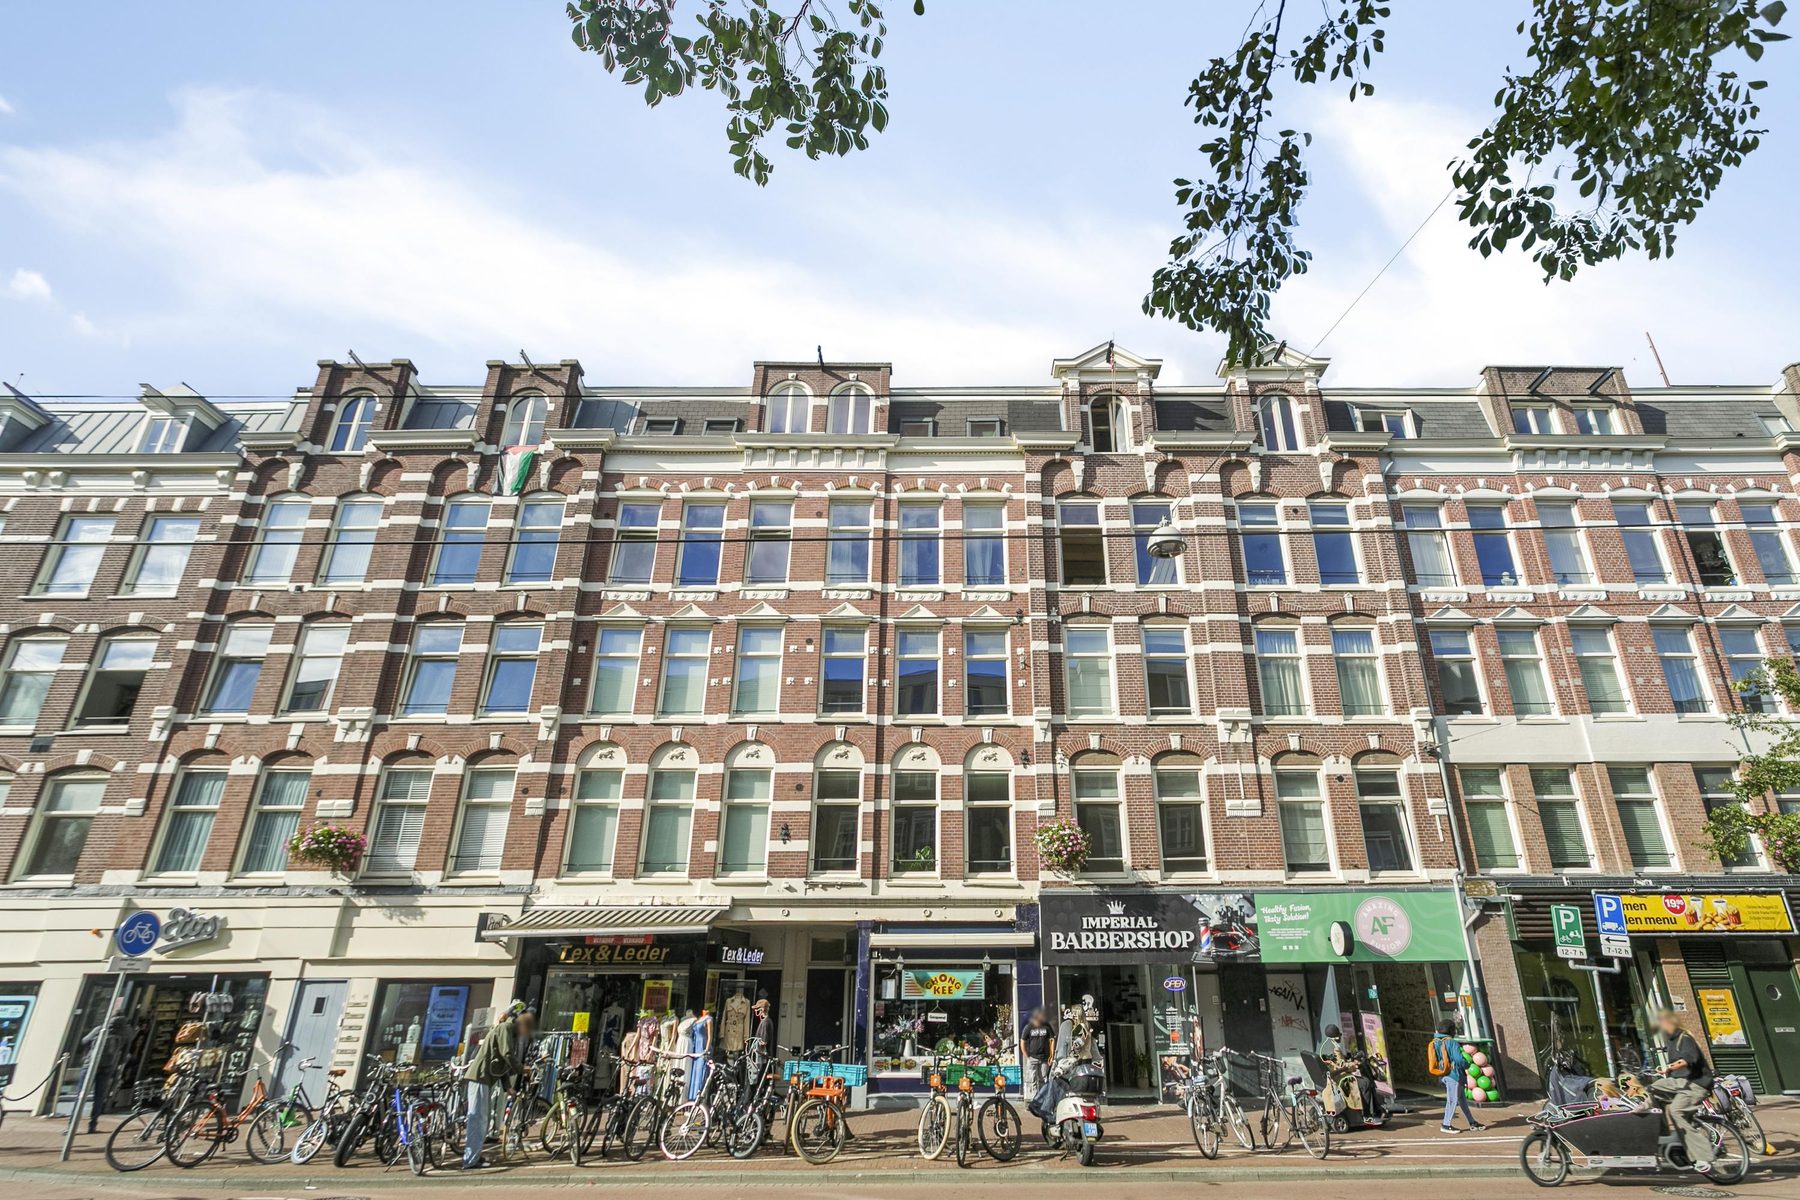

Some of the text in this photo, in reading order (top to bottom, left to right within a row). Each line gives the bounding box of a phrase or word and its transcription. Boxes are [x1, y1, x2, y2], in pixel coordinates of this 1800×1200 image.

[1261, 905, 1287, 914] Healthy
[1362, 903, 1399, 918] AMAZING
[1602, 898, 1617, 918] P
[1623, 902, 1647, 911] men
[159, 908, 220, 942] Etos
[1082, 916, 1158, 929] IMPERIAL
[1371, 916, 1395, 935] AF
[1559, 910, 1575, 930] P
[1645, 917, 1677, 925] menu
[1051, 930, 1195, 950] BARBERSHOP
[934, 985, 953, 995] KEE
[1164, 979, 1186, 989] OPEN
